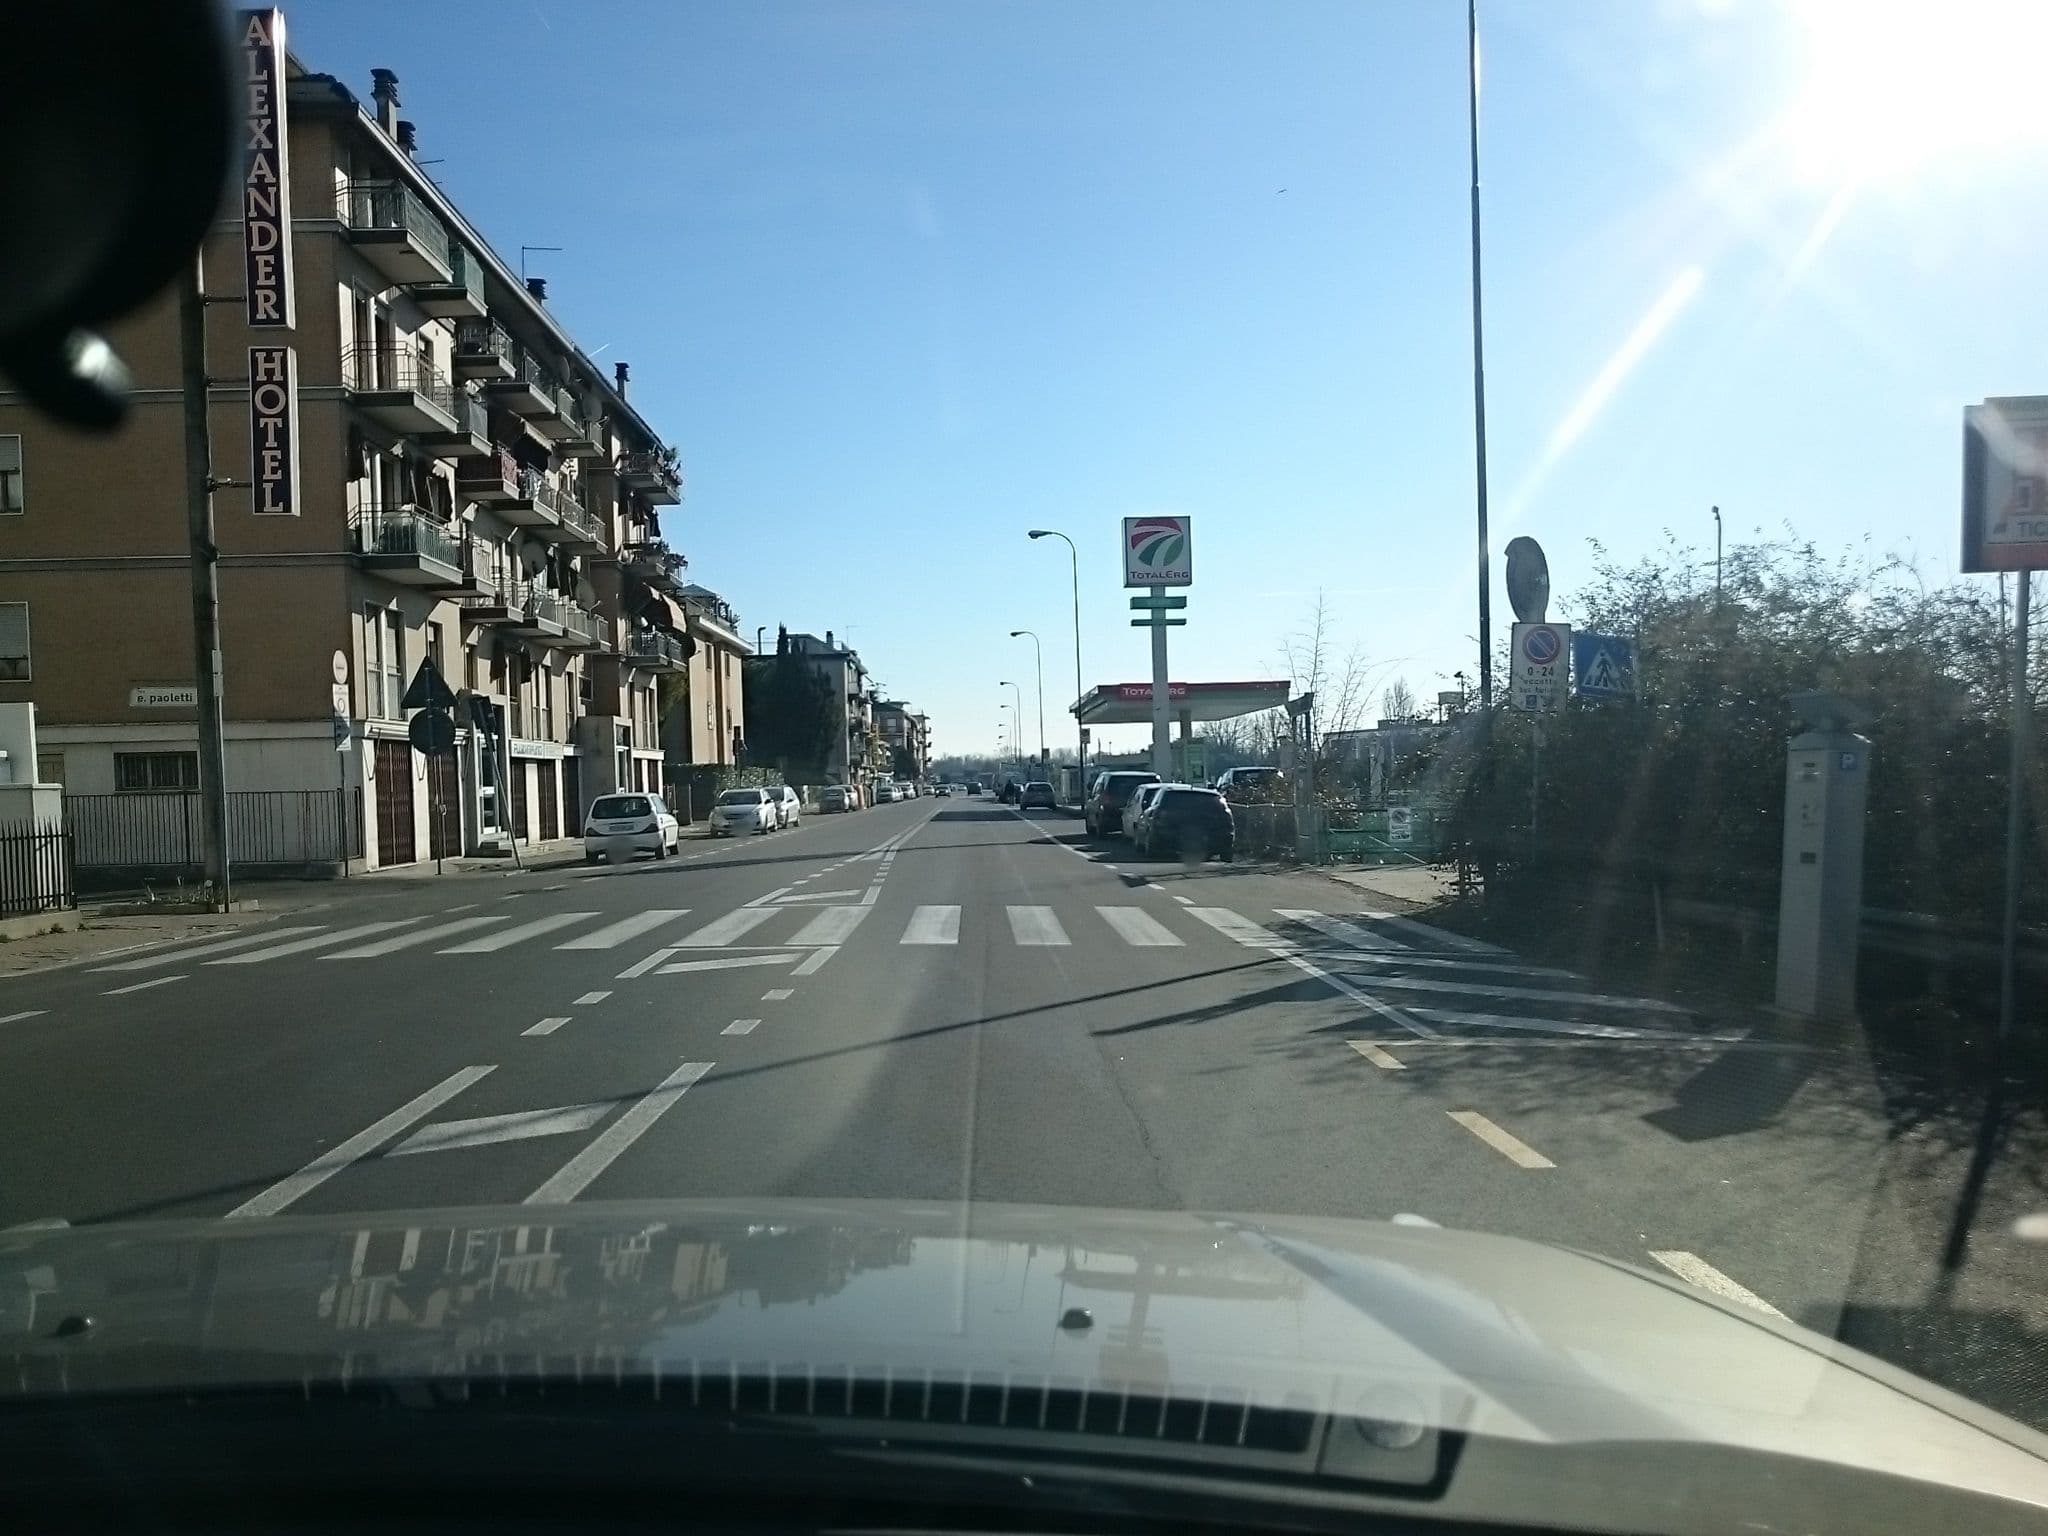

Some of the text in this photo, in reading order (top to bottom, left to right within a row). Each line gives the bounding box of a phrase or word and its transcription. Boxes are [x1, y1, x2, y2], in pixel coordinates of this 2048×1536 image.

[243, 14, 279, 320] ALEXANDER
[254, 351, 287, 513] HOTEL
[149, 693, 193, 705] paoletti
[1123, 687, 1185, 696] TOTARG
